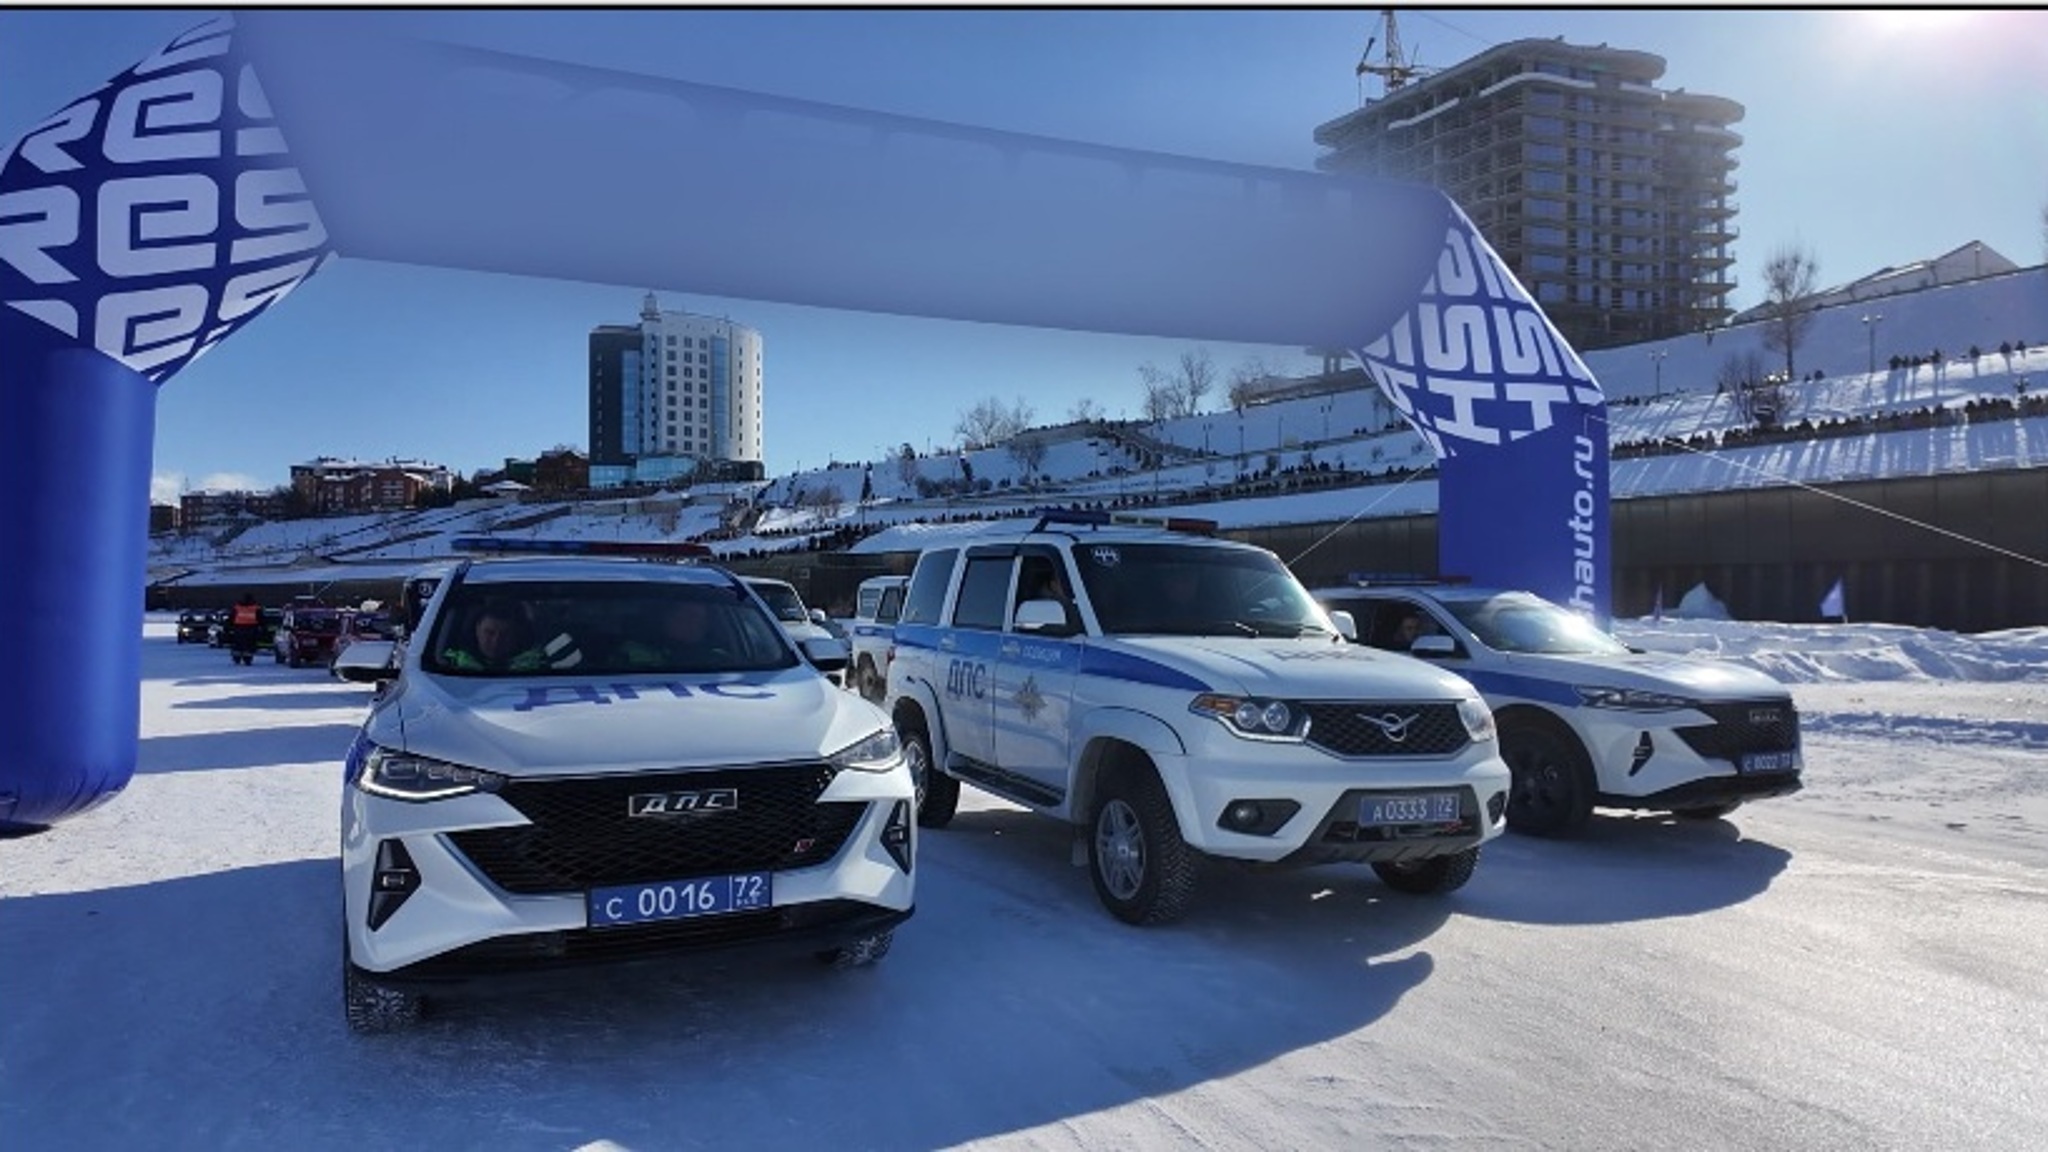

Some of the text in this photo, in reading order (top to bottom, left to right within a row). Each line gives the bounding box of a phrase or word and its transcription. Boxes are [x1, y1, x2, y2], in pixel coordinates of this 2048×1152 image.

[513, 682, 777, 712] ДПС
[948, 658, 986, 701] ДПС
[641, 793, 727, 813] ДПС
[638, 882, 716, 916] 0016
[734, 876, 763, 898] 72
